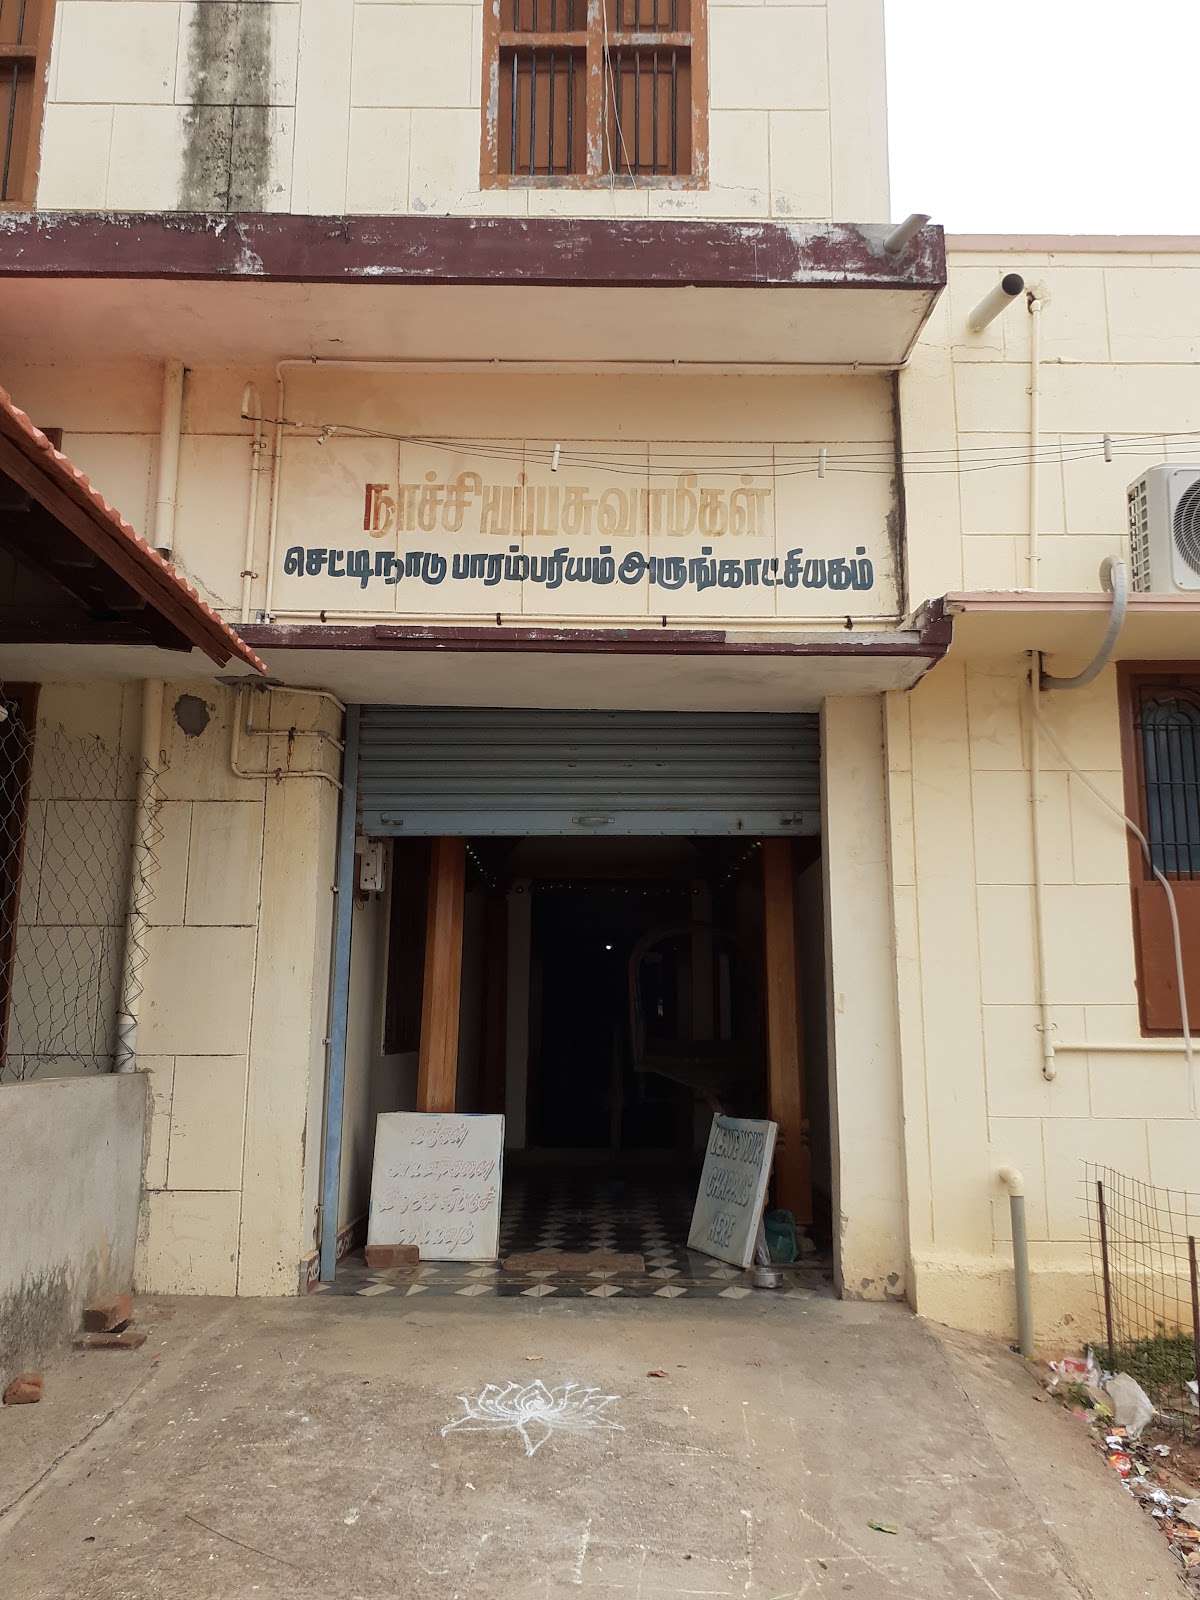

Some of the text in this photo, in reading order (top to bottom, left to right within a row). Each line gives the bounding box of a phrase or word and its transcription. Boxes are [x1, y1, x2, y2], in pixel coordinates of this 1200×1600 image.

[283, 546, 448, 590] செட்டிநாடு
[709, 1123, 765, 1166] LEAVE YOUR
[706, 1211, 737, 1248] HERE
